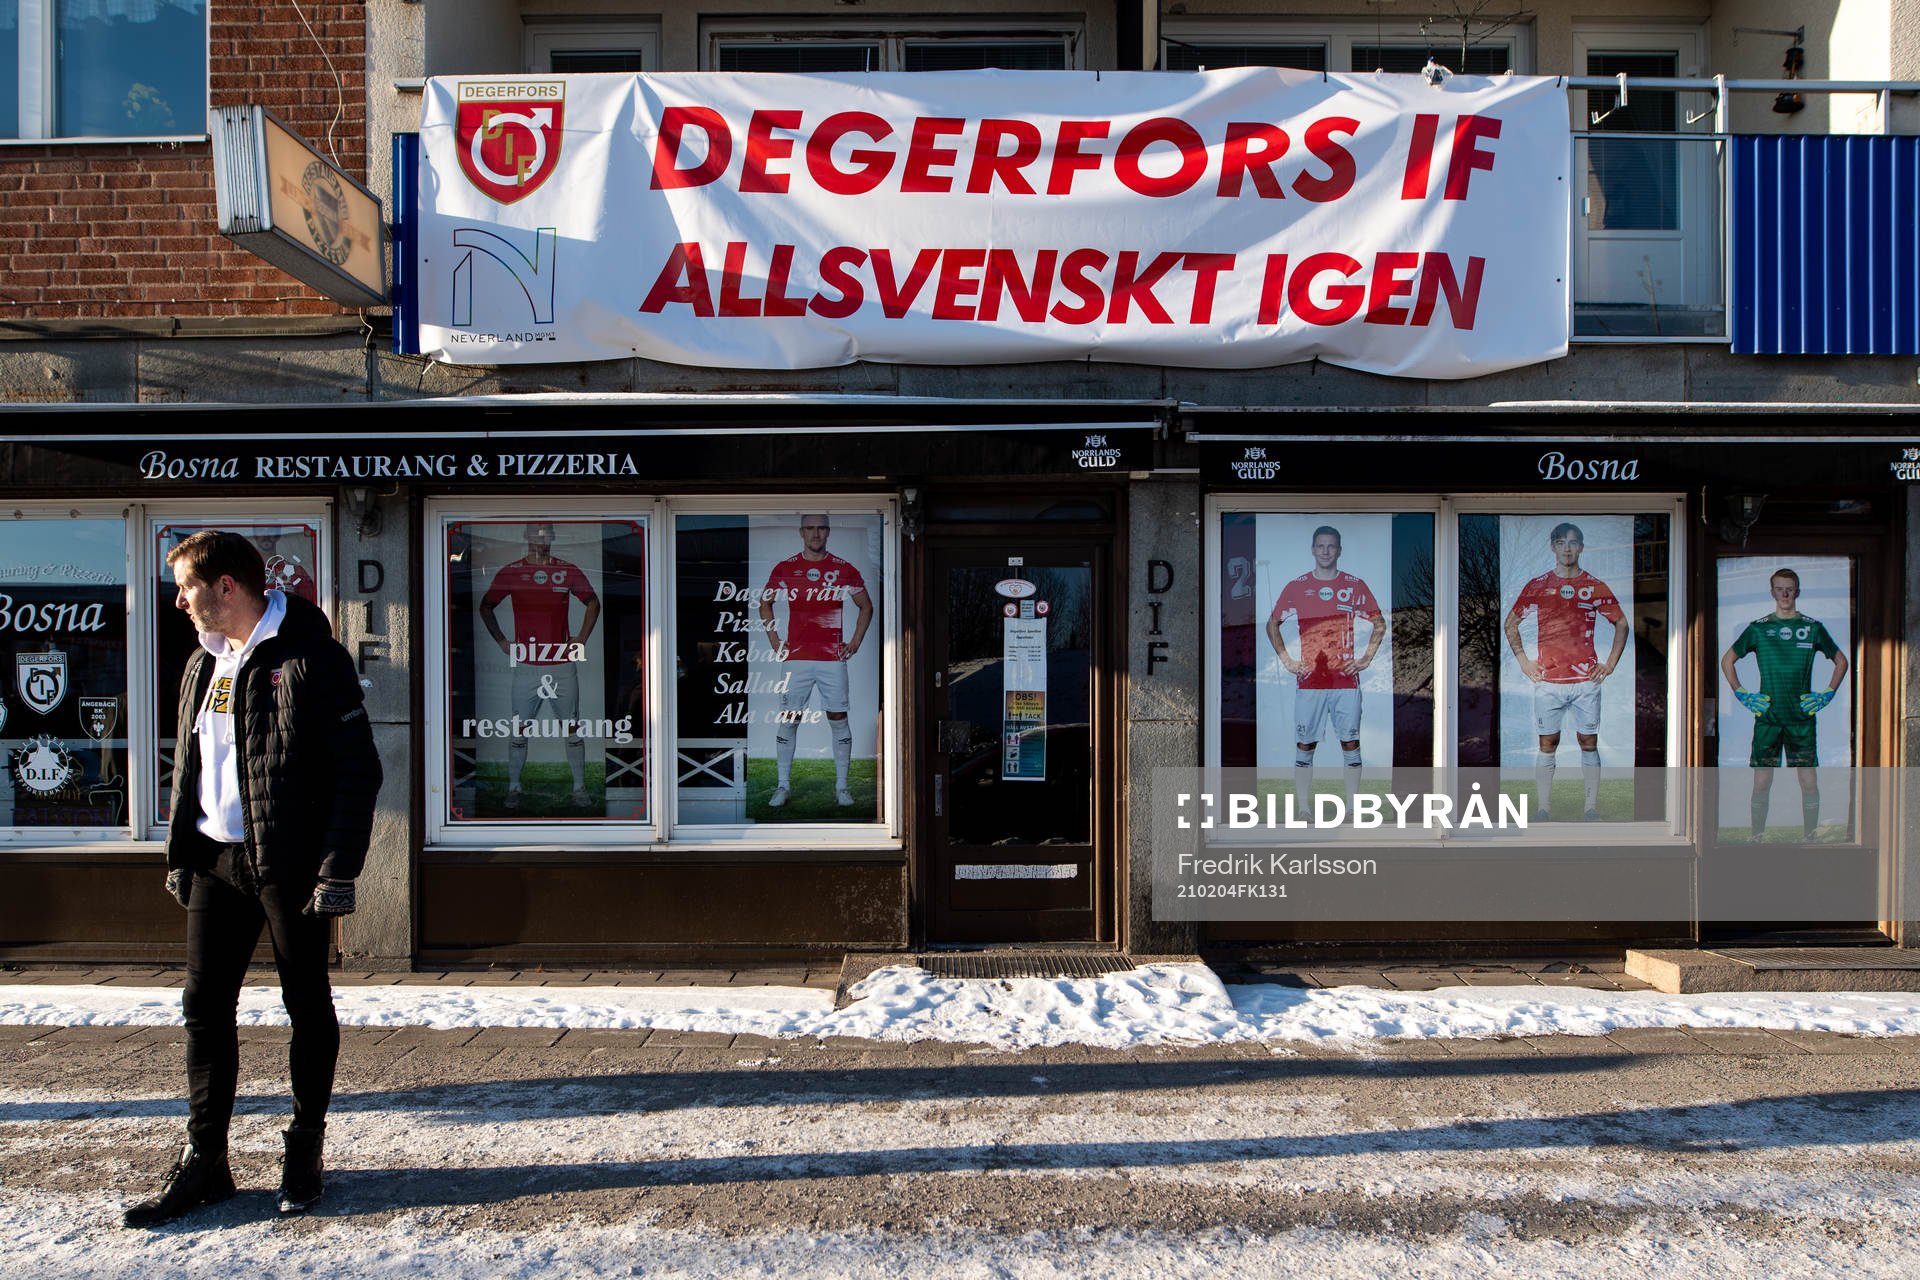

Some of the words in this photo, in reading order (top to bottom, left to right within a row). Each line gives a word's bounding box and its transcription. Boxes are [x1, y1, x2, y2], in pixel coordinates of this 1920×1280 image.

[465, 85, 557, 98] DEGERFORS
[650, 106, 1361, 203] DEGERFORS
[1400, 113, 1503, 201] IF
[639, 242, 1236, 325] ALLSVENSKT
[1256, 252, 1486, 331] IGEN
[451, 332, 534, 343] NEVERLAND
[139, 450, 240, 479] Bosna
[255, 454, 458, 479] RESTAURANG
[466, 454, 489, 477] &
[497, 453, 640, 477] PIZZERIA
[1072, 448, 1121, 459] NORRLANDS
[1078, 455, 1117, 468] GULD
[1231, 461, 1281, 471] NORRLANDS
[1237, 468, 1276, 480] GULD
[1538, 451, 1640, 481] Bosna
[713, 580, 799, 609] Dagens
[714, 611, 780, 633] Pizza
[509, 636, 588, 668] pizza
[714, 640, 790, 663] Kebab
[536, 674, 559, 700] &
[713, 672, 792, 694] Sallad
[764, 707, 822, 724] carte
[462, 714, 633, 744] restaurang
[26, 769, 63, 780] D.I.F.
